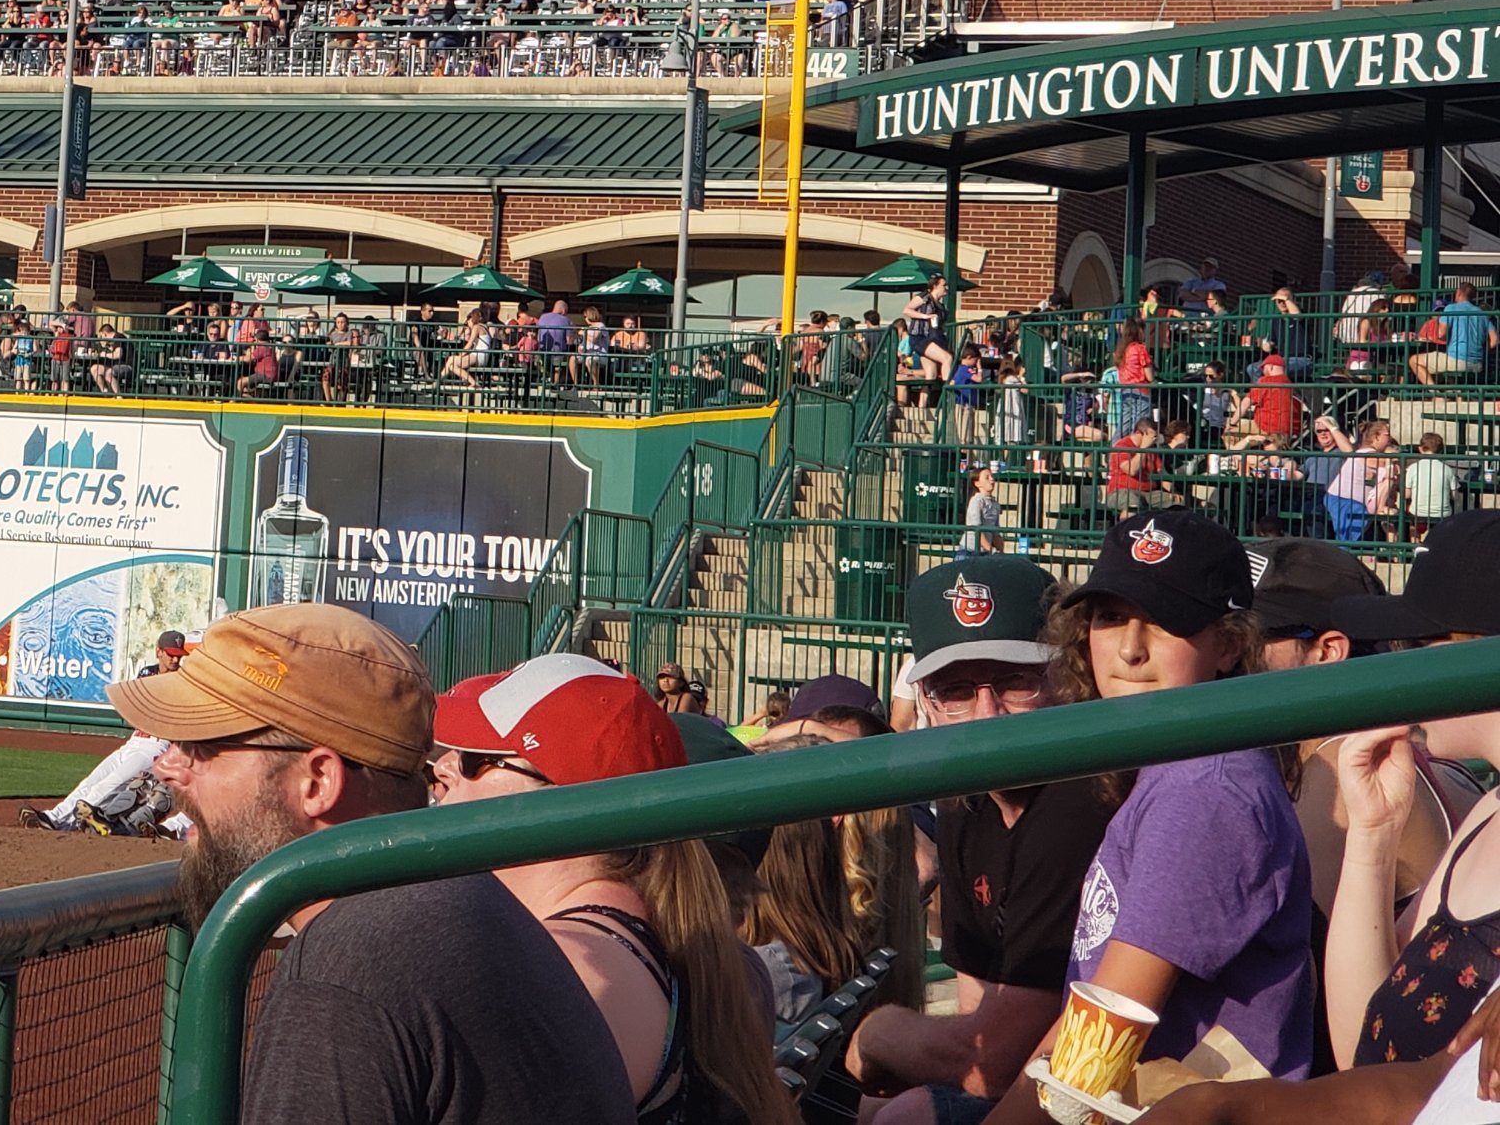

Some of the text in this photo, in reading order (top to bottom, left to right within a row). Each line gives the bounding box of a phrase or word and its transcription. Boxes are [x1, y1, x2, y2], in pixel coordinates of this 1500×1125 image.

[806, 52, 848, 79] 442
[876, 53, 1184, 141] HUNTINGTON
[230, 247, 302, 257] PARKVIEW FIELD
[244, 272, 275, 283] EVENT
[135, 484, 181, 509] INC.
[14, 509, 65, 530] Quality
[66, 511, 112, 529] Comes
[6, 530, 43, 543] Service
[44, 532, 102, 547] Restoration
[104, 534, 154, 553] Company
[337, 527, 391, 575] IT'S
[397, 529, 476, 580] YOUR
[335, 576, 371, 602] NEW
[19, 650, 94, 680] Water
